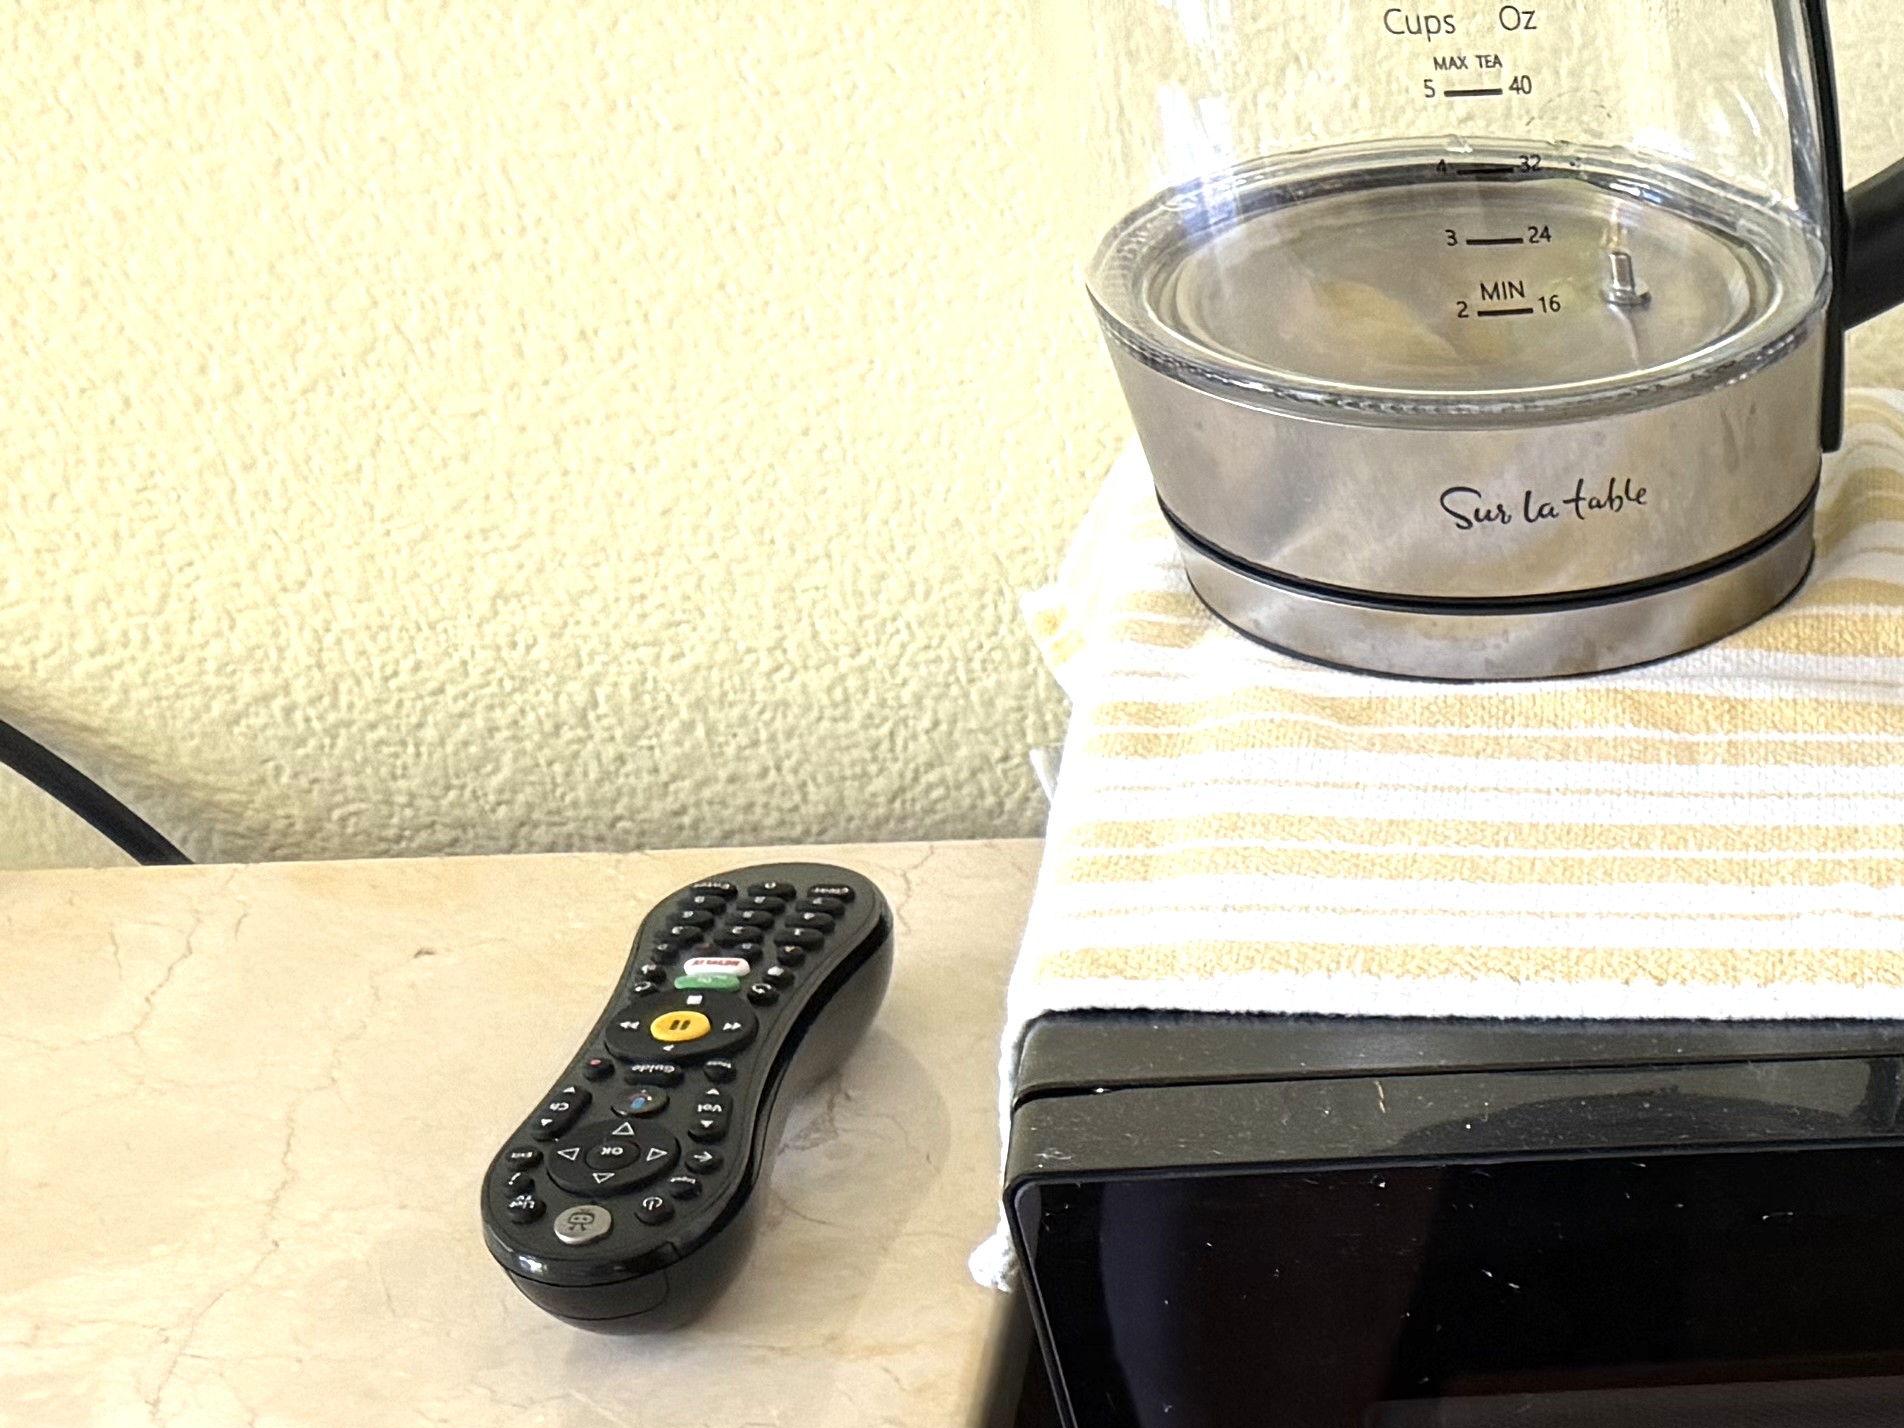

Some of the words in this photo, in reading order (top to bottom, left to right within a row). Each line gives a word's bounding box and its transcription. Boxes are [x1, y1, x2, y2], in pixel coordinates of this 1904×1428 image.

[1383, 7, 1456, 43] Cups
[1498, 5, 1538, 31] Oz
[1433, 56, 1469, 71] MAX
[1475, 54, 1503, 69] TEA
[1423, 79, 1436, 98] 5
[1508, 75, 1533, 95] 40
[1518, 154, 1543, 174] 32
[1445, 229, 1458, 247] 3
[1528, 225, 1552, 244] 24
[1480, 280, 1525, 301] MIN
[1456, 301, 1469, 318] 2
[1538, 294, 1561, 313] 16
[1440, 486, 1512, 530] Sur
[1523, 490, 1559, 523] la
[1562, 477, 1647, 520] table
[697, 1103, 723, 1113] Vol
[600, 1146, 624, 1156] OK
